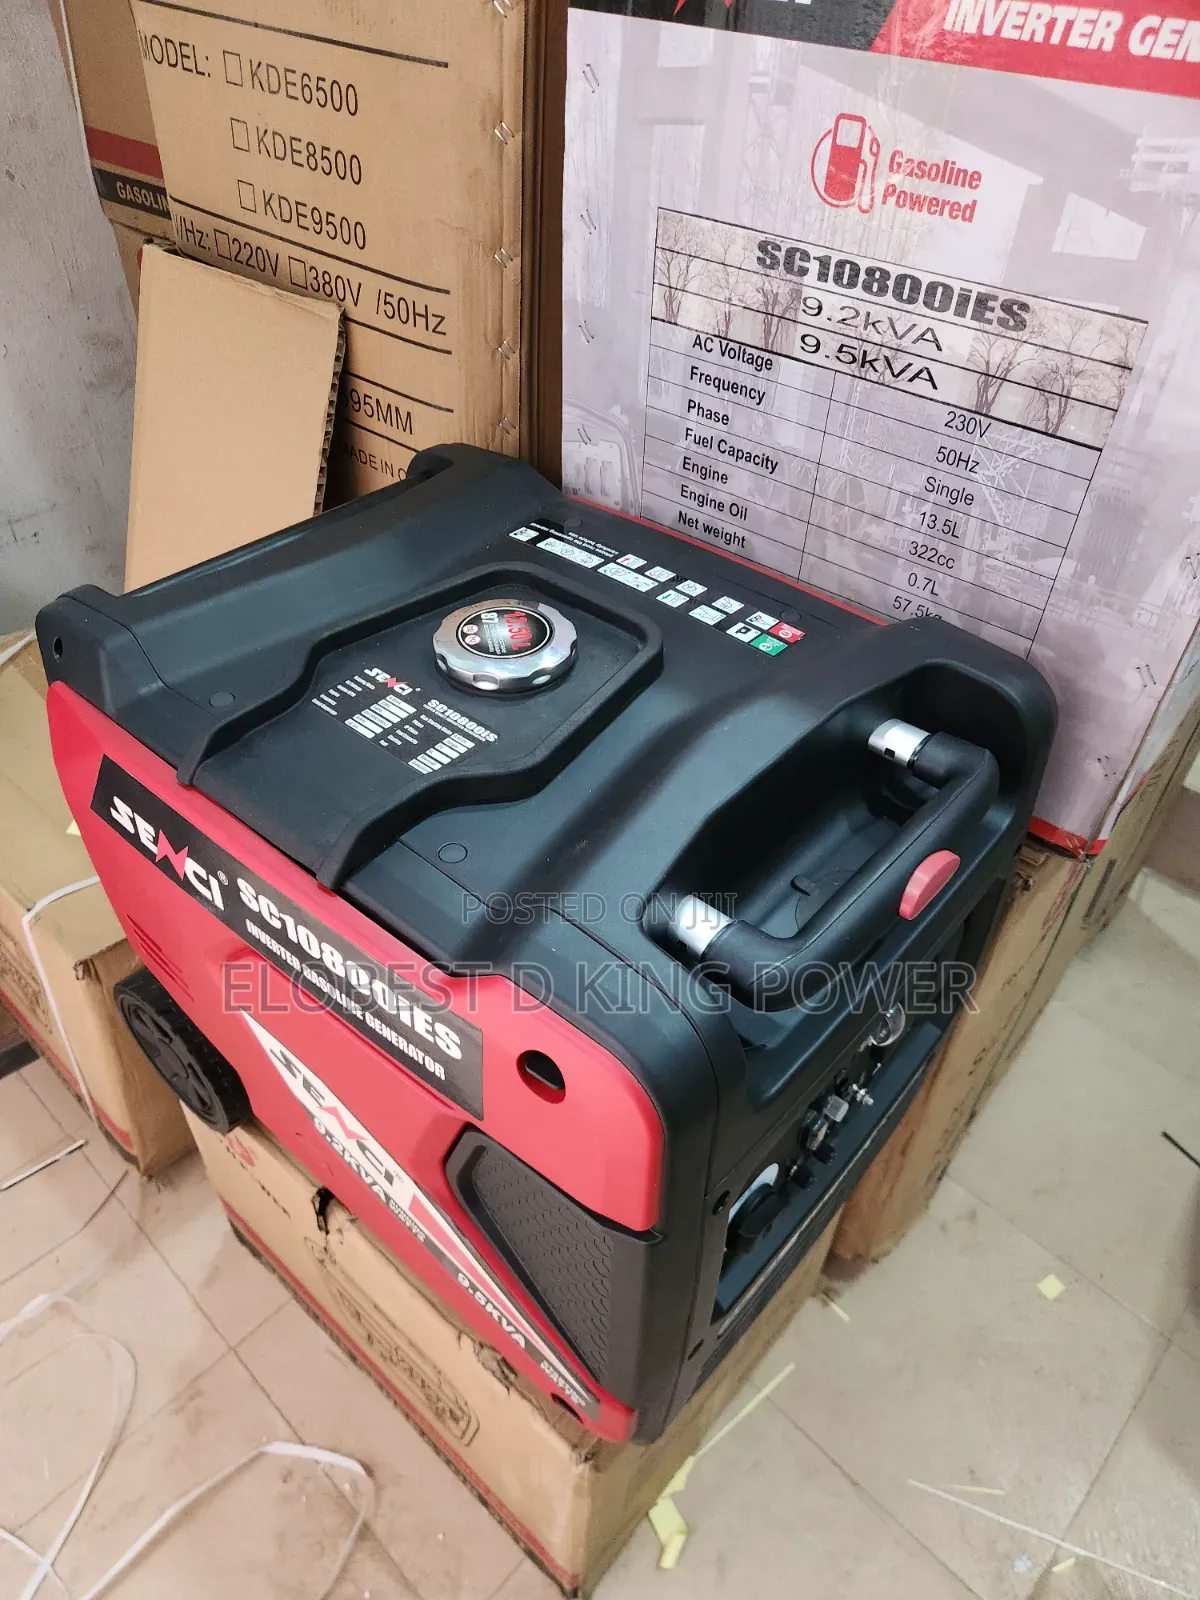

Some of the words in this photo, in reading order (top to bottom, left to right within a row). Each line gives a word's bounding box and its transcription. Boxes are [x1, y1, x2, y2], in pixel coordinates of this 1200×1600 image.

[943, 0, 1122, 52] INVERTER
[250, 58, 359, 116] KDE6500
[256, 125, 362, 185] KDE8500
[888, 149, 982, 190] Gasoline
[262, 188, 367, 251] KDE9500
[881, 183, 978, 223] Powered
[232, 237, 279, 277] 220V
[309, 265, 362, 307] 380V
[375, 288, 447, 336] /50Hz
[756, 239, 1030, 332] SC10800iES
[801, 296, 943, 352] 9.2kVA
[692, 334, 714, 353] AC
[718, 340, 773, 372] Voltage
[799, 333, 939, 391] 9.5kVA
[690, 365, 766, 406] Frequency
[687, 398, 730, 426] Phase
[944, 410, 992, 438] 230V
[380, 459, 394, 478] IN
[682, 456, 729, 485] Engine
[685, 427, 714, 448] Fuel
[717, 439, 779, 475] Capacity
[935, 445, 980, 474] 50Hz
[680, 484, 726, 512] Engine
[729, 502, 748, 521] Oil
[924, 476, 975, 507] Single
[678, 510, 699, 531] Net
[702, 523, 746, 549] weight
[919, 511, 960, 539] 13.5L
[908, 541, 955, 570] 322cc
[907, 572, 940, 597] 0.7L
[481, 612, 498, 623] 87
[892, 595, 943, 619] 57.5k
[109, 795, 224, 911] SENCI
[245, 918, 301, 972] INVERTER
[364, 1012, 446, 1081] GENERATOR
[269, 1046, 395, 1187] SENCI
[312, 1115, 388, 1201] 9.2KVA
[455, 1270, 527, 1349] 9.5KVA
